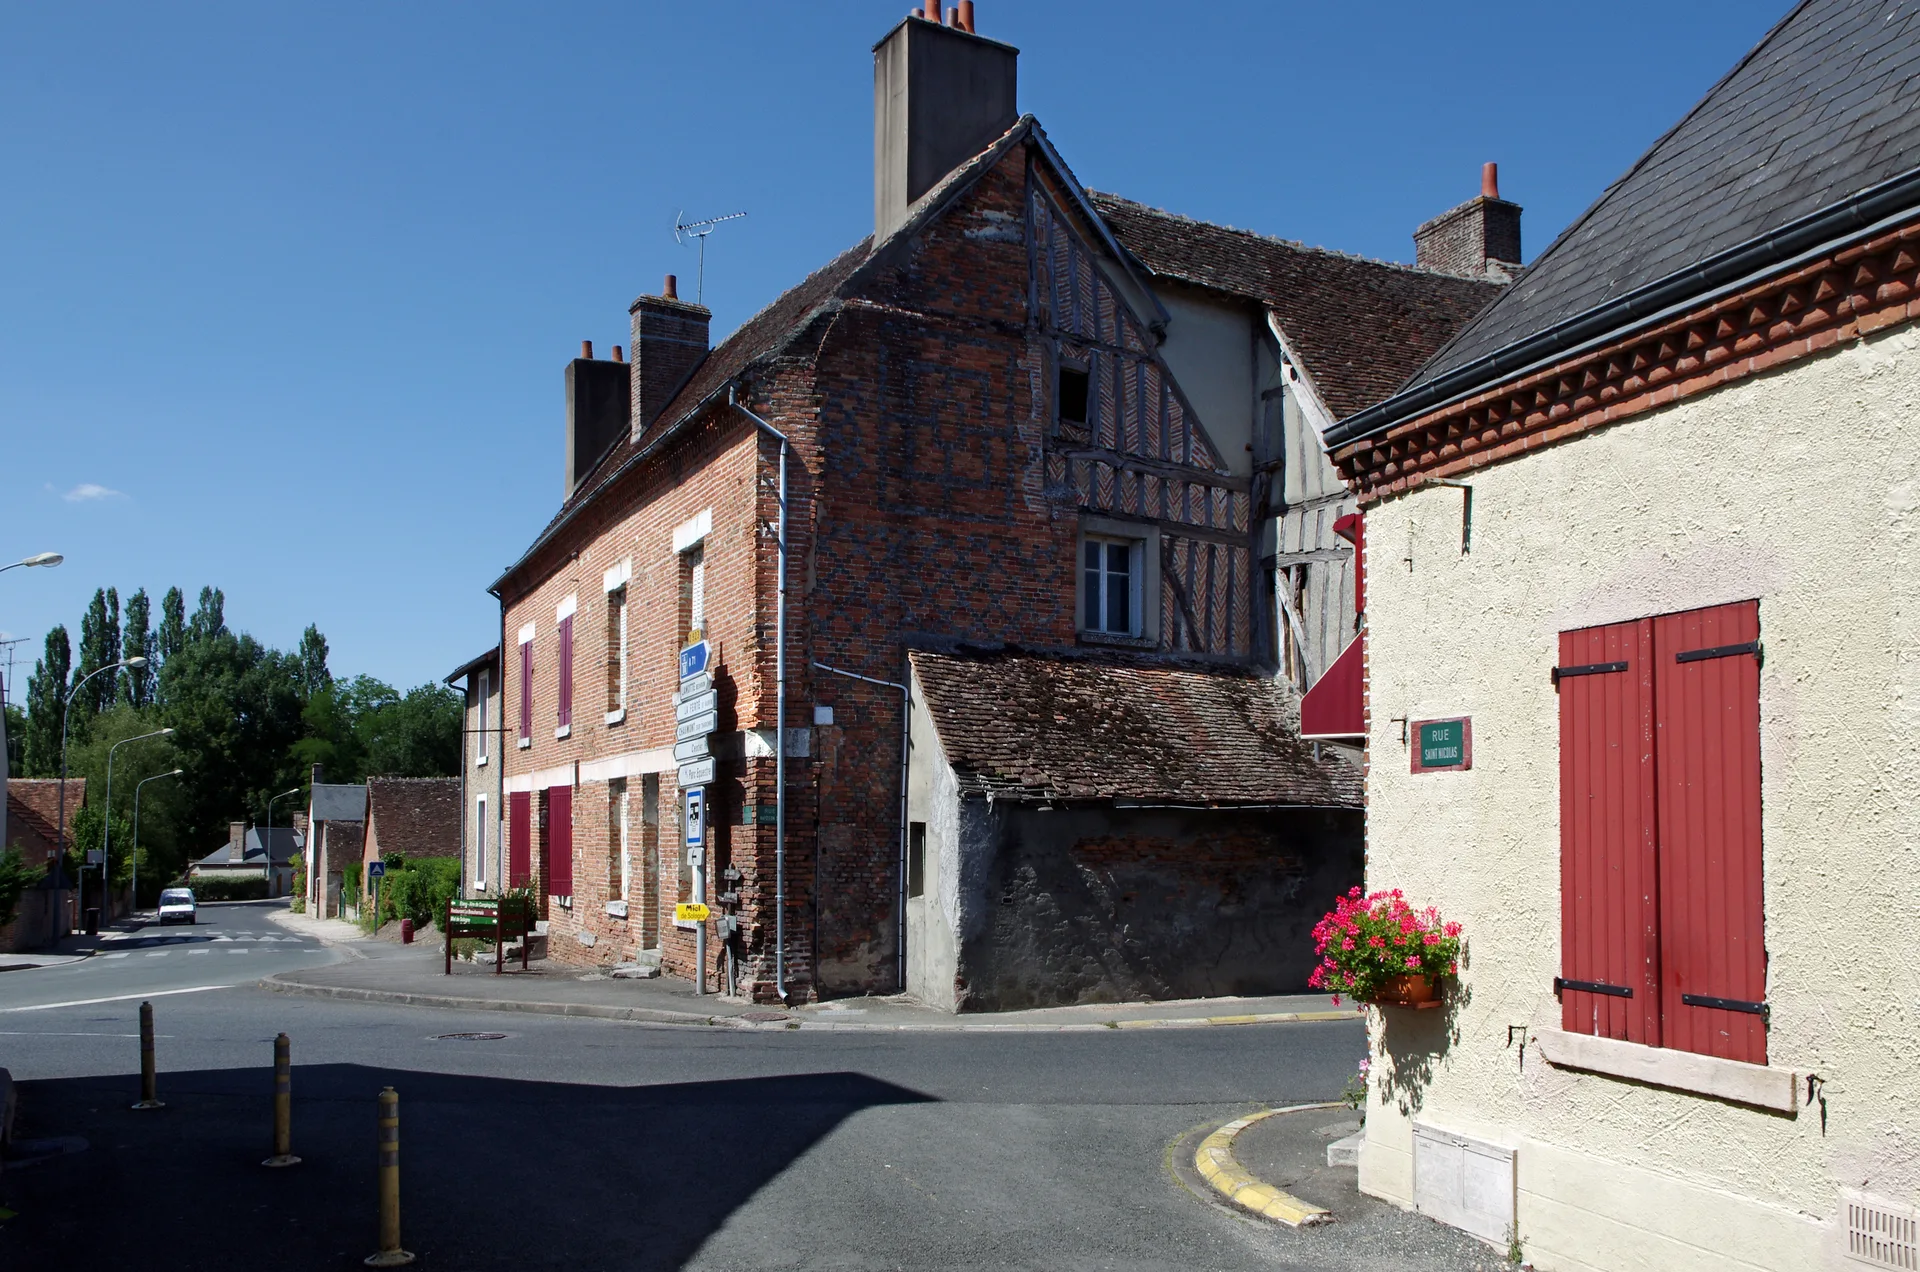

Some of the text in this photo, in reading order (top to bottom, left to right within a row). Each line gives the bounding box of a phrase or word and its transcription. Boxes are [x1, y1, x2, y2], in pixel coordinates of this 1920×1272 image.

[682, 682, 696, 695] LAMOTTE
[679, 722, 696, 736] CHAUMONT
[1432, 729, 1449, 741] RUE
[1425, 746, 1458, 760] SAINT NICOLAS
[686, 904, 701, 912] Miel
